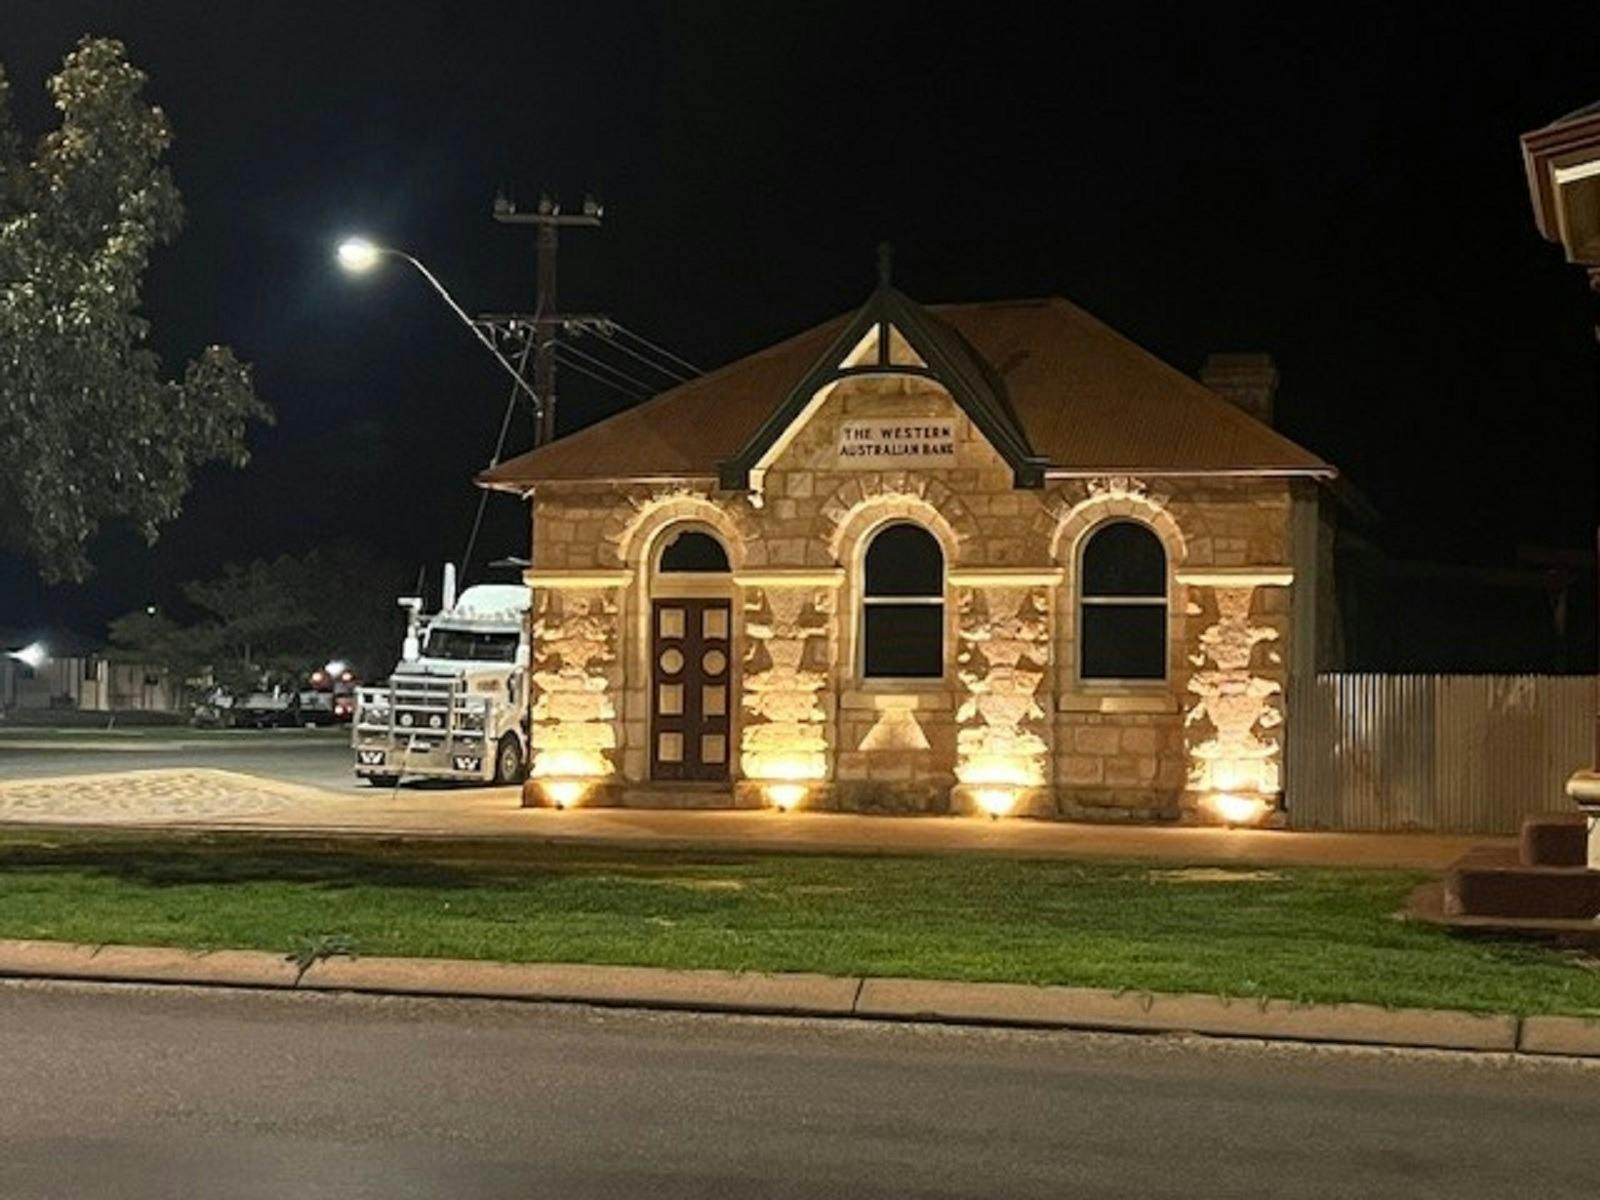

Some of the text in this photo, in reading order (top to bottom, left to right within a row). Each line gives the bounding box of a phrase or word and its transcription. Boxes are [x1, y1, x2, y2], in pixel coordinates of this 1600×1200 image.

[843, 427, 950, 440] THE WESTERN
[840, 443, 954, 456] AUSTRALIAN BANK
